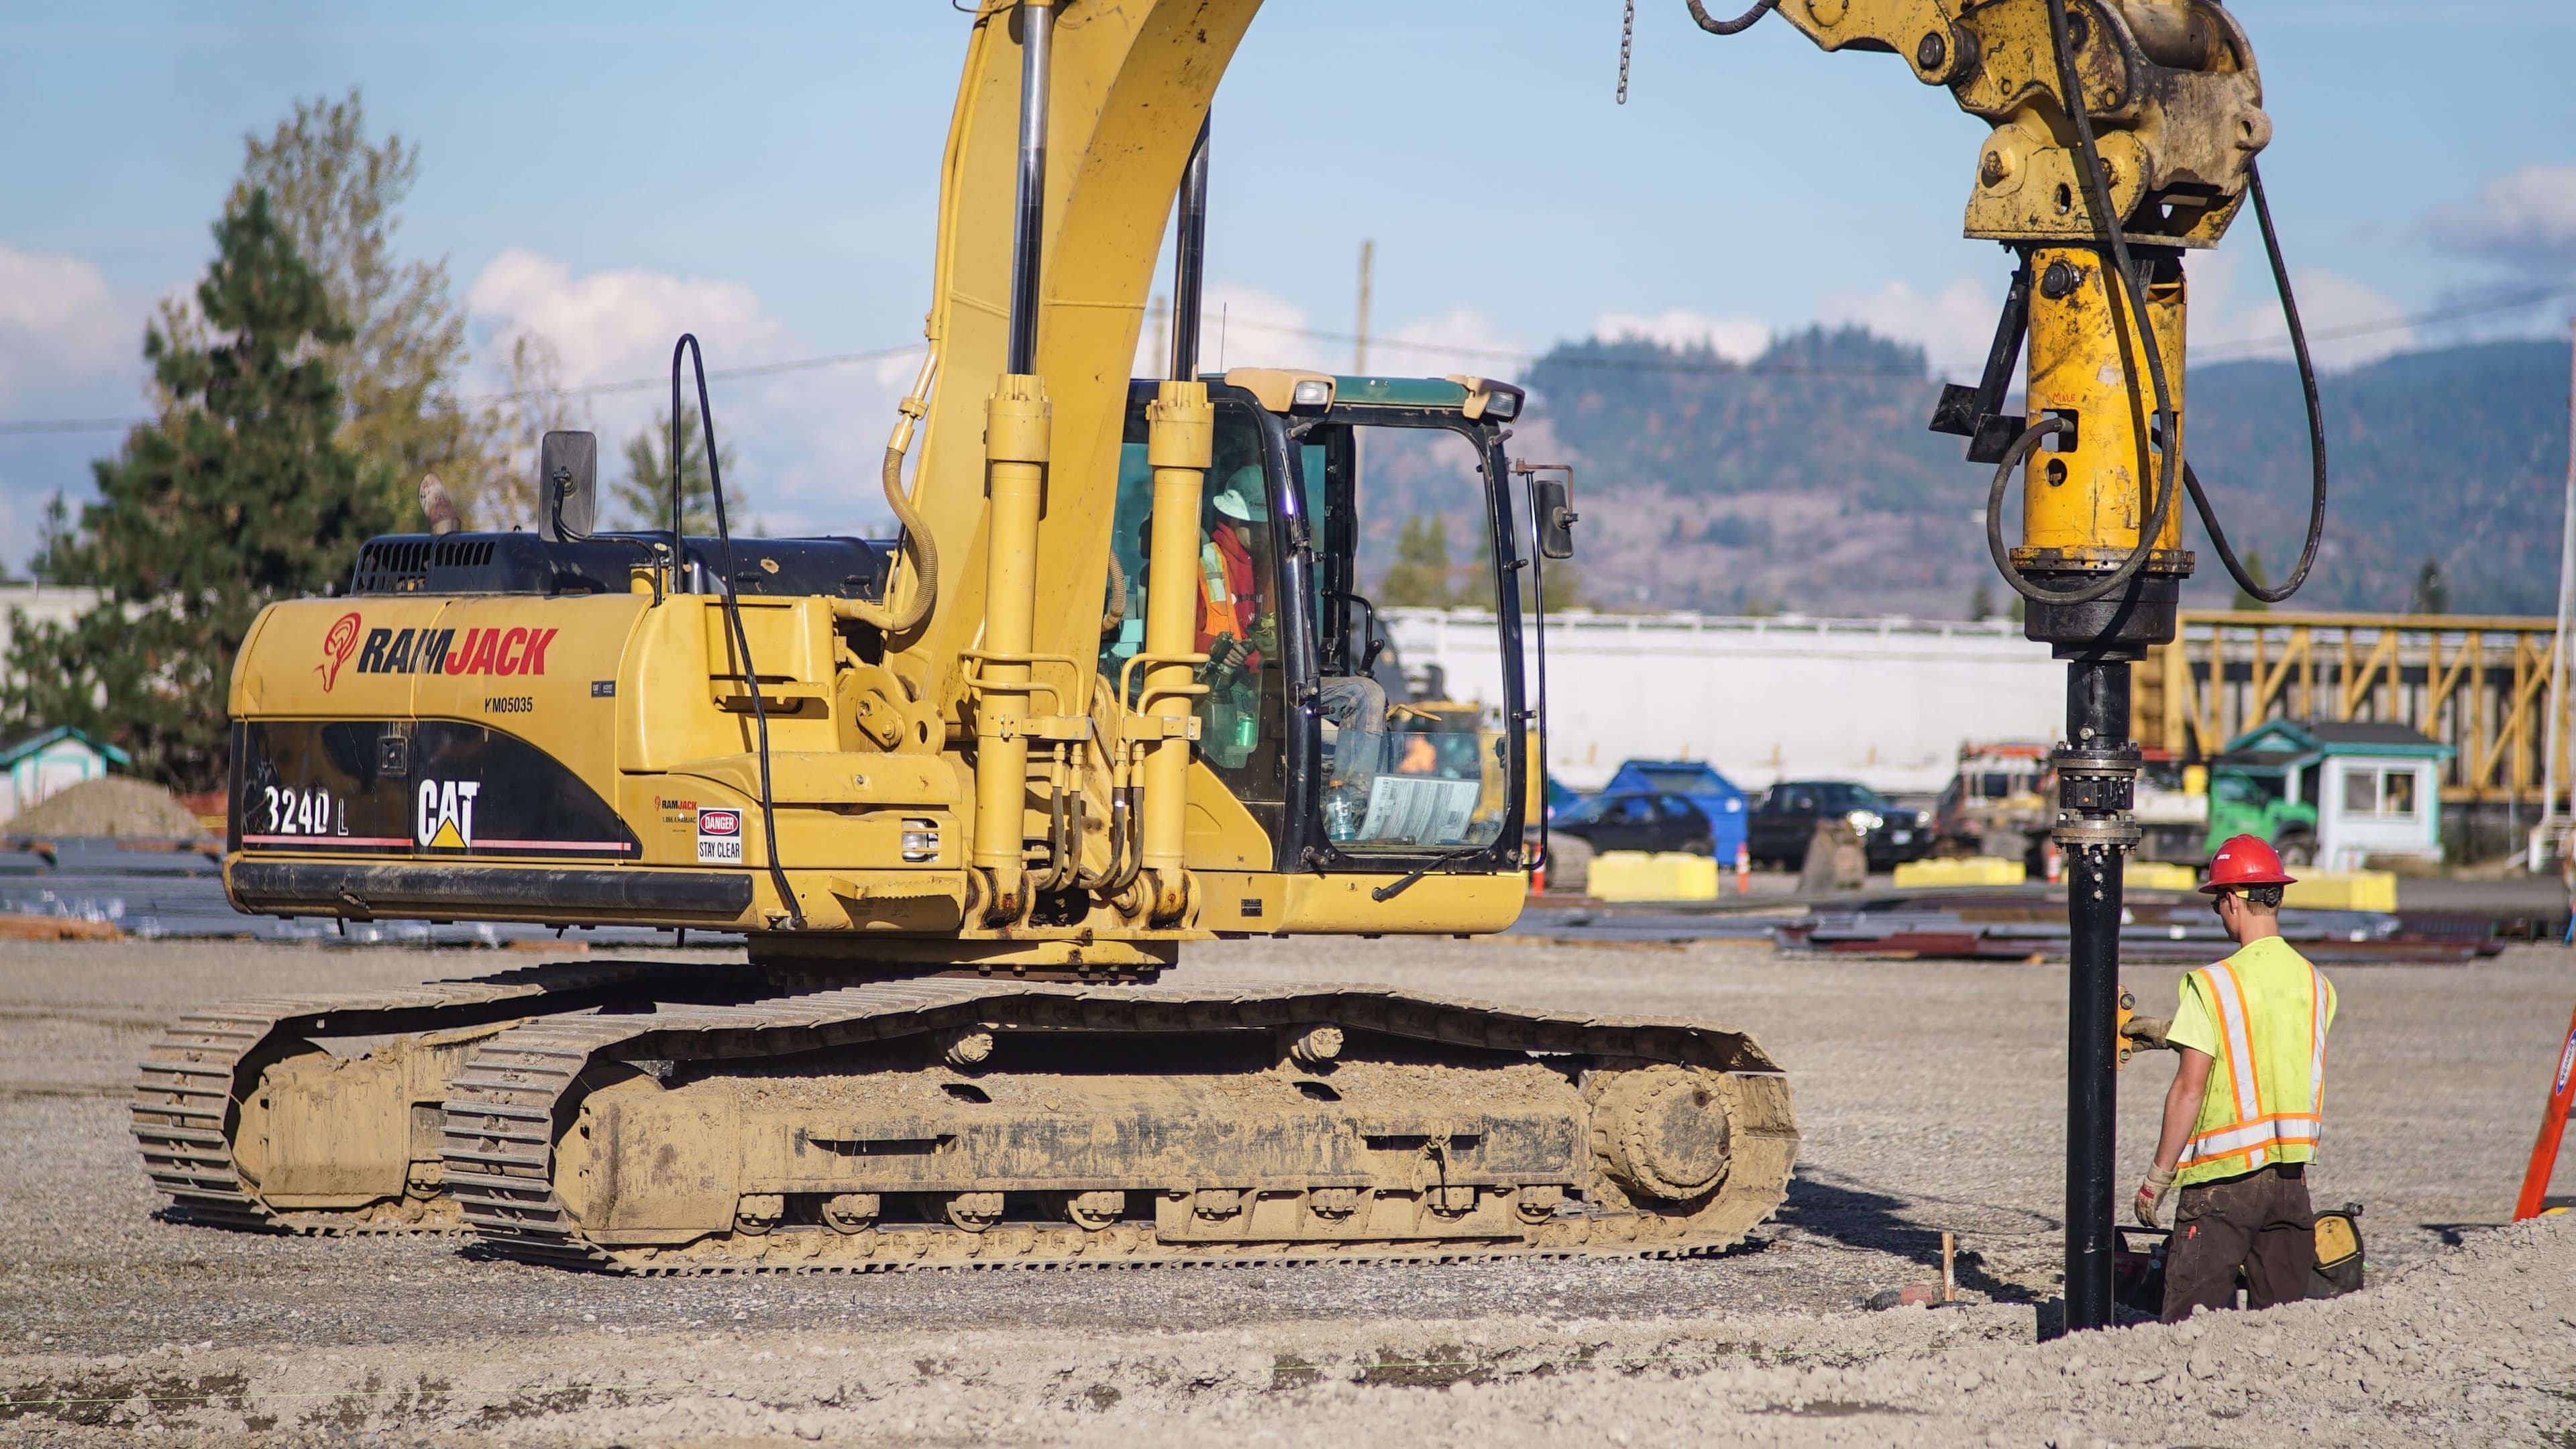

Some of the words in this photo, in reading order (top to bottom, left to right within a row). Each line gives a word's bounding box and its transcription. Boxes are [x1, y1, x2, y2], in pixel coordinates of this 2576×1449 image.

[337, 798, 349, 836] L
[418, 779, 478, 847] CAT
[705, 816, 735, 830] DANGER
[699, 842, 716, 857] STAY
[717, 843, 740, 858] CLEAR
